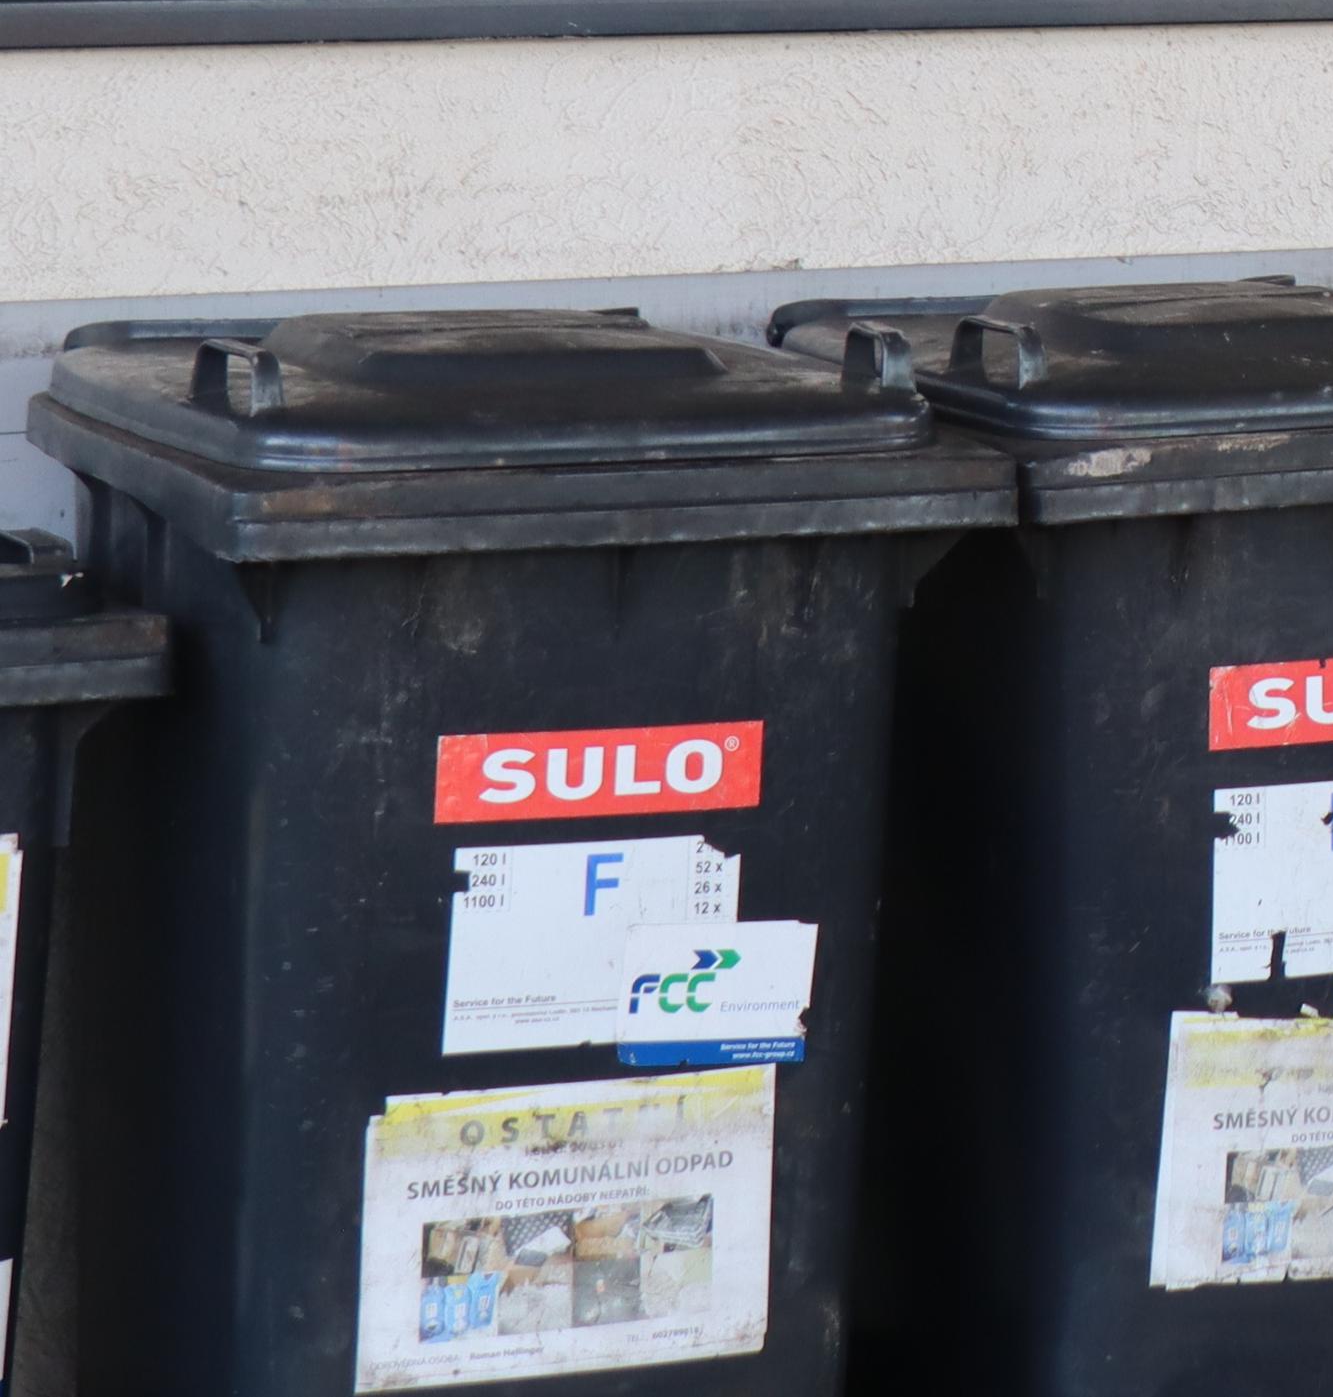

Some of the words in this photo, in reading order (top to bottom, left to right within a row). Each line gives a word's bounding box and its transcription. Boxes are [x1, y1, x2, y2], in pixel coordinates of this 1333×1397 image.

[1230, 793, 1252, 806] 120
[472, 853, 498, 866] 120
[695, 862, 711, 873] 52
[715, 863, 723, 873] x
[471, 874, 497, 887] 240
[584, 852, 625, 916] F
[694, 882, 710, 894] 26
[714, 883, 723, 893] x
[463, 895, 496, 908] 1100
[694, 902, 710, 915] 12
[713, 903, 721, 913] x
[1218, 931, 1251, 940] Service
[1252, 929, 1265, 938] for
[628, 972, 718, 1015] FCC
[453, 998, 489, 1008] Service
[491, 996, 505, 1005] for
[507, 995, 522, 1004] the
[525, 993, 556, 1003] Future
[719, 999, 801, 1013] Environment
[1213, 1107, 1298, 1131] SMĚSNÝ
[1291, 1133, 1308, 1144] DO
[406, 1171, 502, 1202] SMĚSNÝ
[508, 1156, 650, 1191] KOMUNÁLNÍ
[655, 1150, 734, 1176] ODPAD
[495, 1200, 512, 1211] DO
[515, 1196, 545, 1210] TÉTO
[547, 1191, 597, 1206] NÁDOBY
[469, 1349, 501, 1360] Roman
